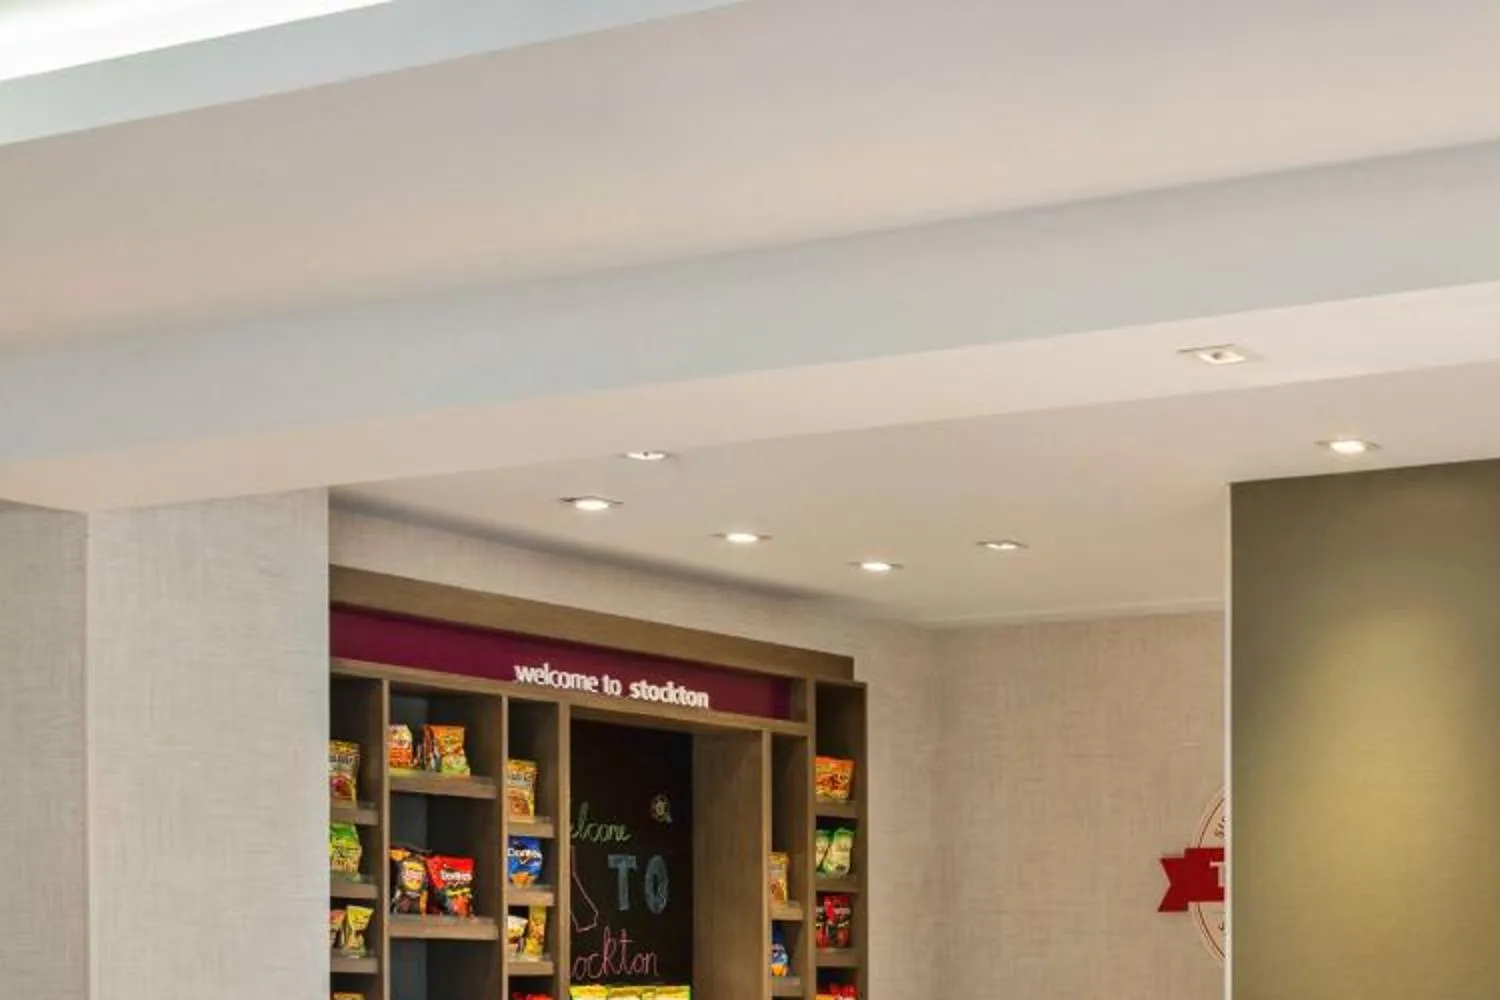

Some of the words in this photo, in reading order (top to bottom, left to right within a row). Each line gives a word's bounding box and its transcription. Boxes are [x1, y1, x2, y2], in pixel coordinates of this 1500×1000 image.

[514, 662, 599, 693] welcome
[602, 674, 622, 697] to
[629, 679, 709, 708] stockton
[607, 854, 670, 915] TO
[573, 925, 660, 981] ockton
